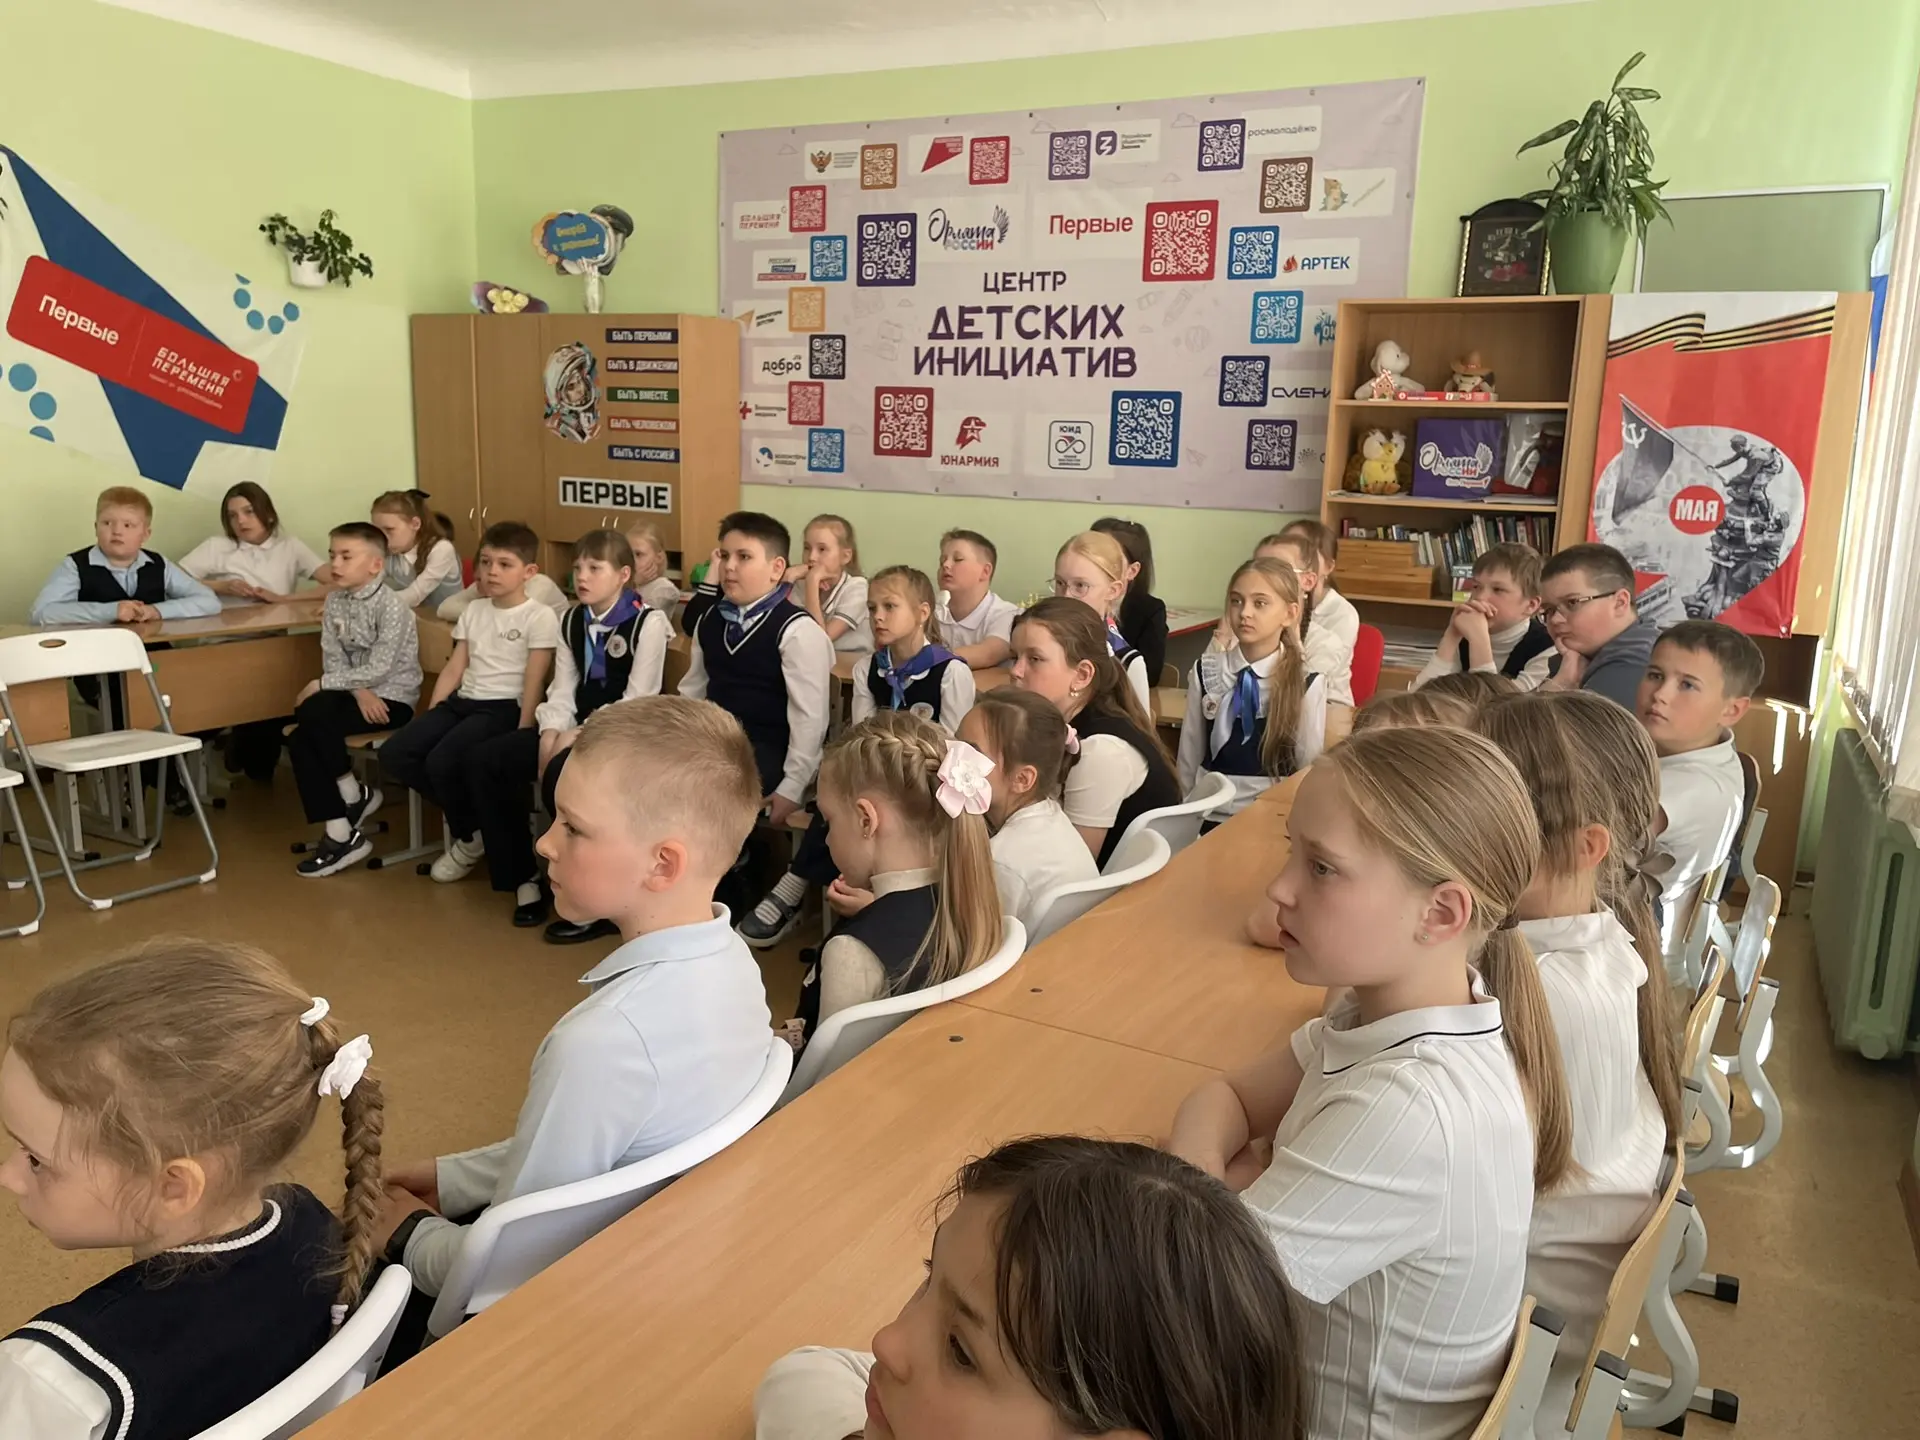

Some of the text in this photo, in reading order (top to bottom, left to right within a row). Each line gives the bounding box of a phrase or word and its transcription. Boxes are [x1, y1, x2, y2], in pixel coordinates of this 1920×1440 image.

[928, 207, 996, 246] Орлята
[1049, 215, 1134, 240] Первые
[944, 239, 994, 251] РОССИИ
[1301, 255, 1351, 270] АРТЕК
[983, 271, 1067, 295] ЦЕНТР
[38, 293, 120, 346] Первые
[927, 303, 1126, 341] ДЕТСКИХ
[157, 346, 231, 388] БОЛЬШАЯ
[762, 357, 802, 375] добро
[913, 346, 1138, 380] ИНИЦИАТИВ
[151, 356, 225, 397] ПЕРЕМЕНА
[1059, 425, 1082, 434] ЮИД
[940, 454, 1000, 468] ЮНАРМИЯ
[561, 480, 669, 509] ПЕРВЫЕ
[1674, 498, 1720, 522] МАЯ
